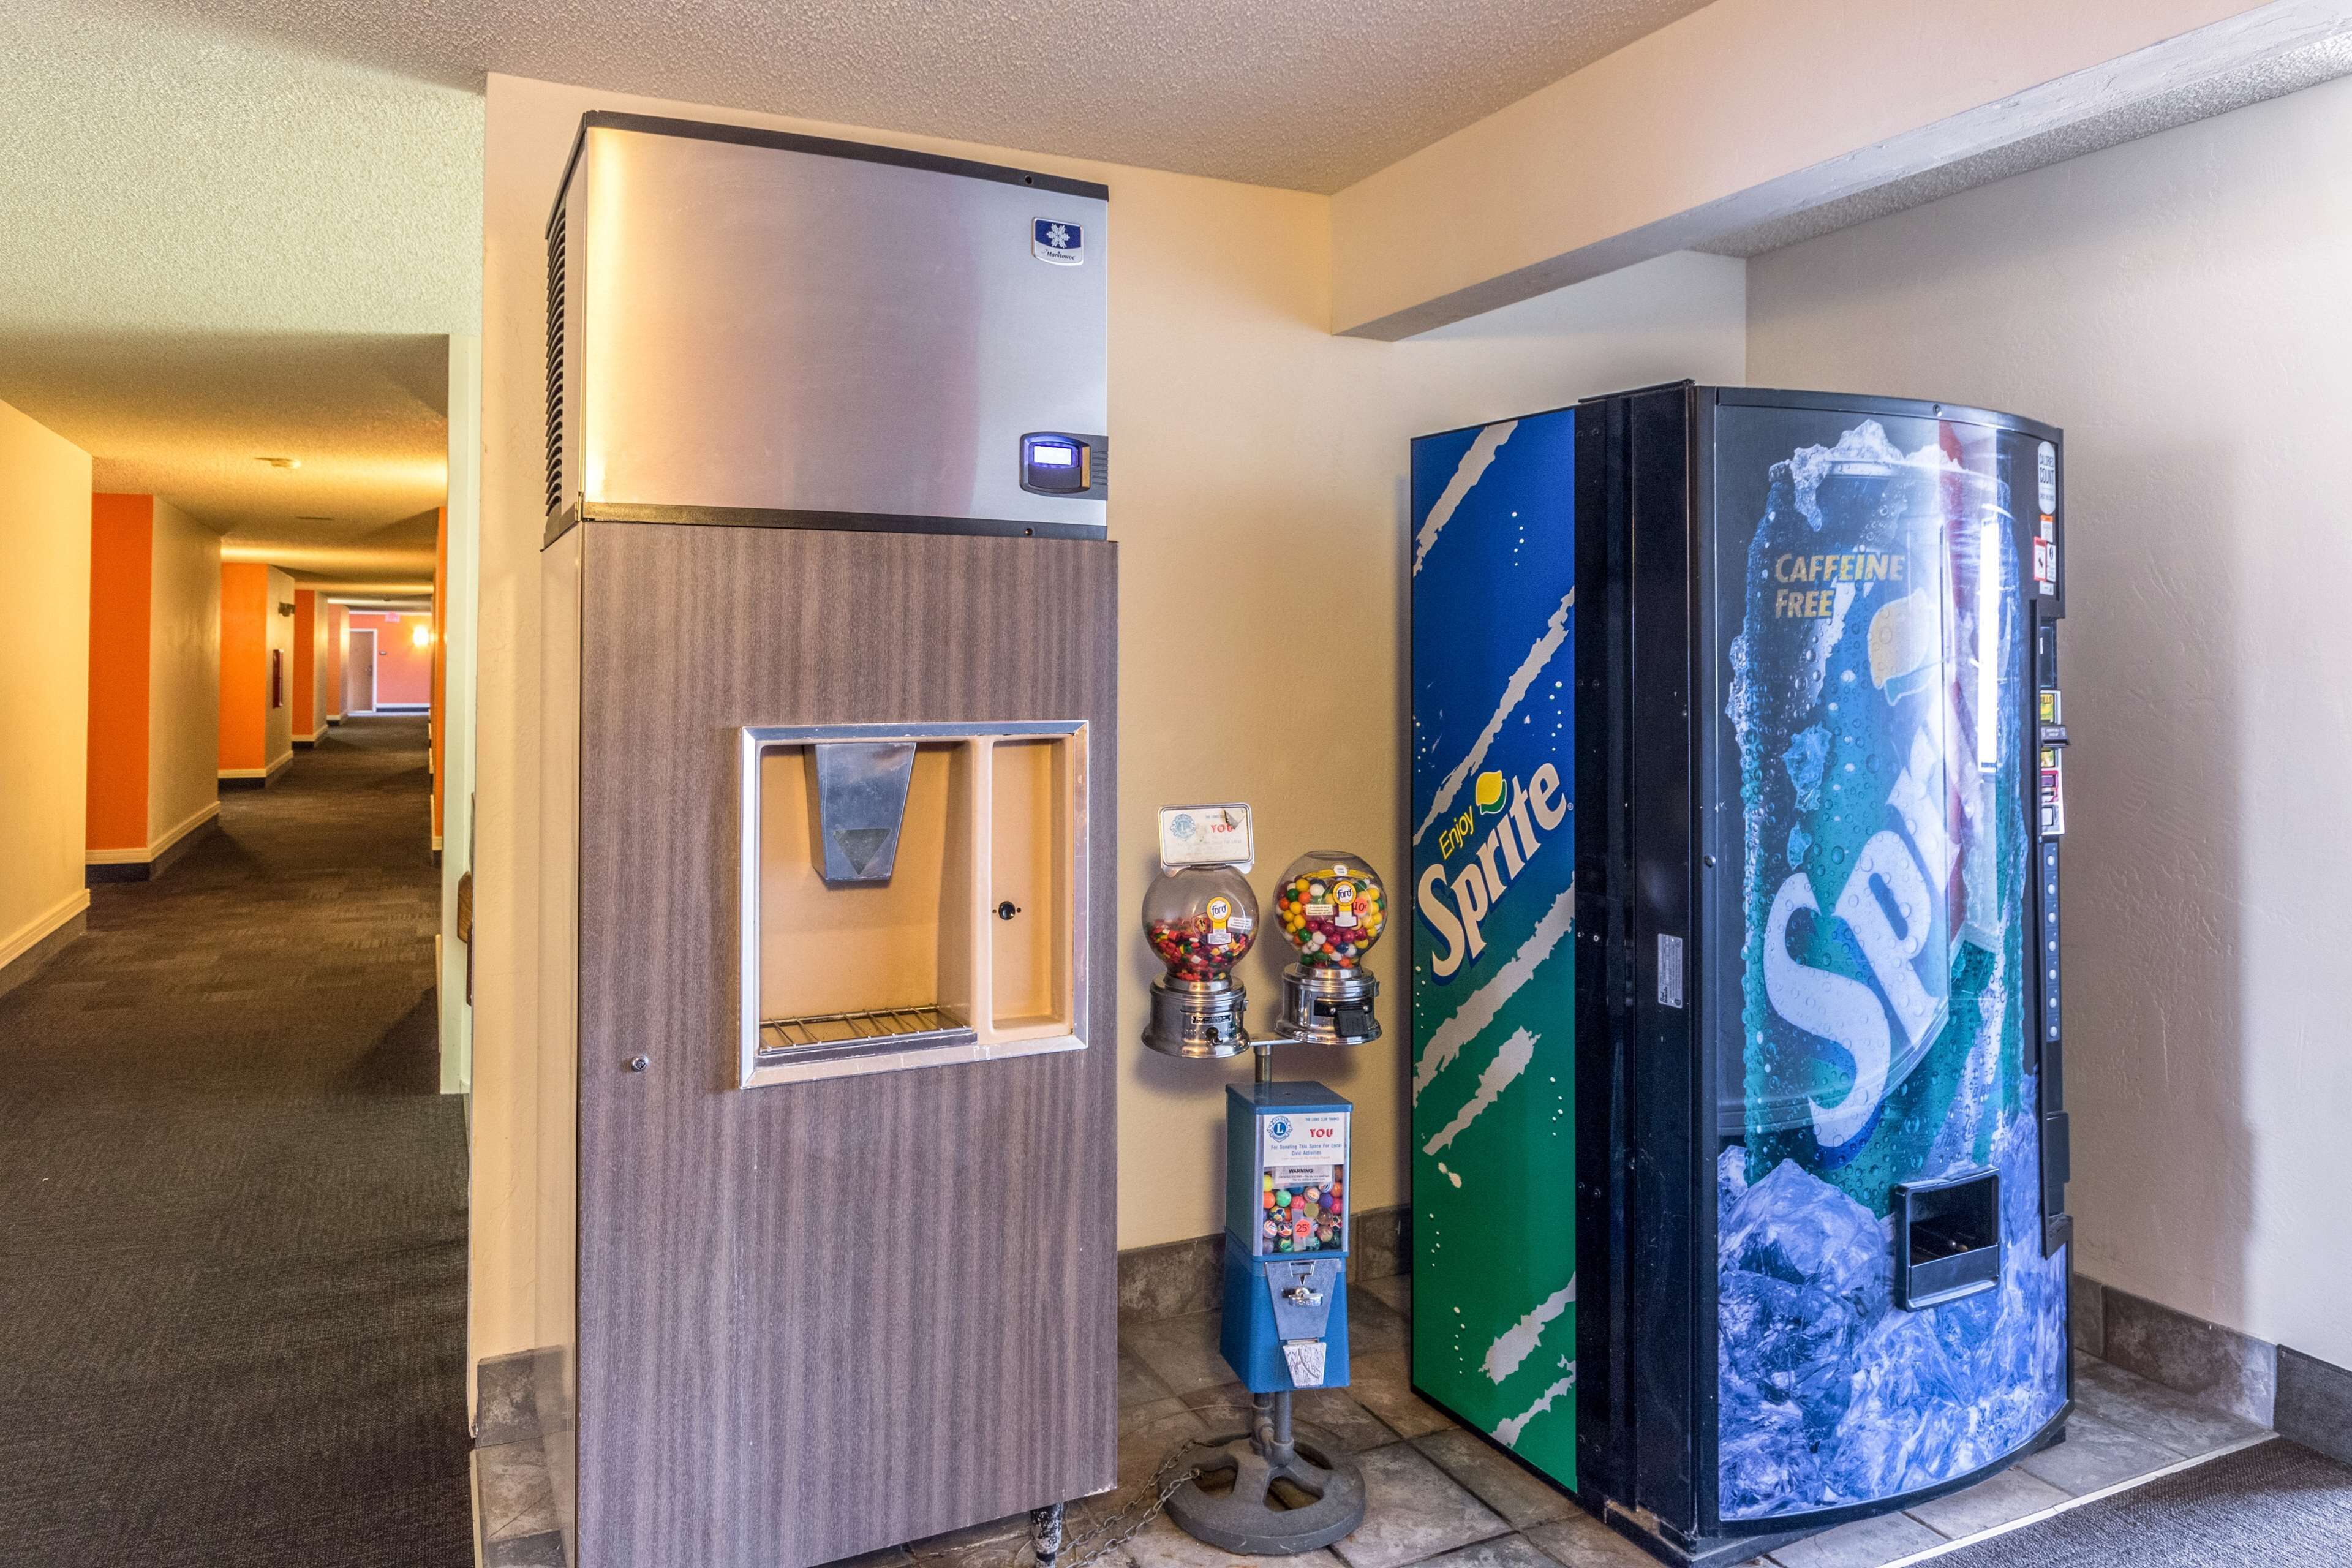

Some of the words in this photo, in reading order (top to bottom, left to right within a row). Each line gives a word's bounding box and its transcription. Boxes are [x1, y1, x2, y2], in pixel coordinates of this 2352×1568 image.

[1047, 251, 1076, 260] Manitowoc
[1776, 552, 1907, 583] CAFFEINE
[1776, 589, 1838, 619] FREE
[1439, 805, 1474, 861] Enjoy
[1417, 763, 1567, 977] Sprite
[1337, 888, 1352, 900] ford
[1212, 904, 1227, 916] ford
[1310, 1128, 1333, 1137] YOU
